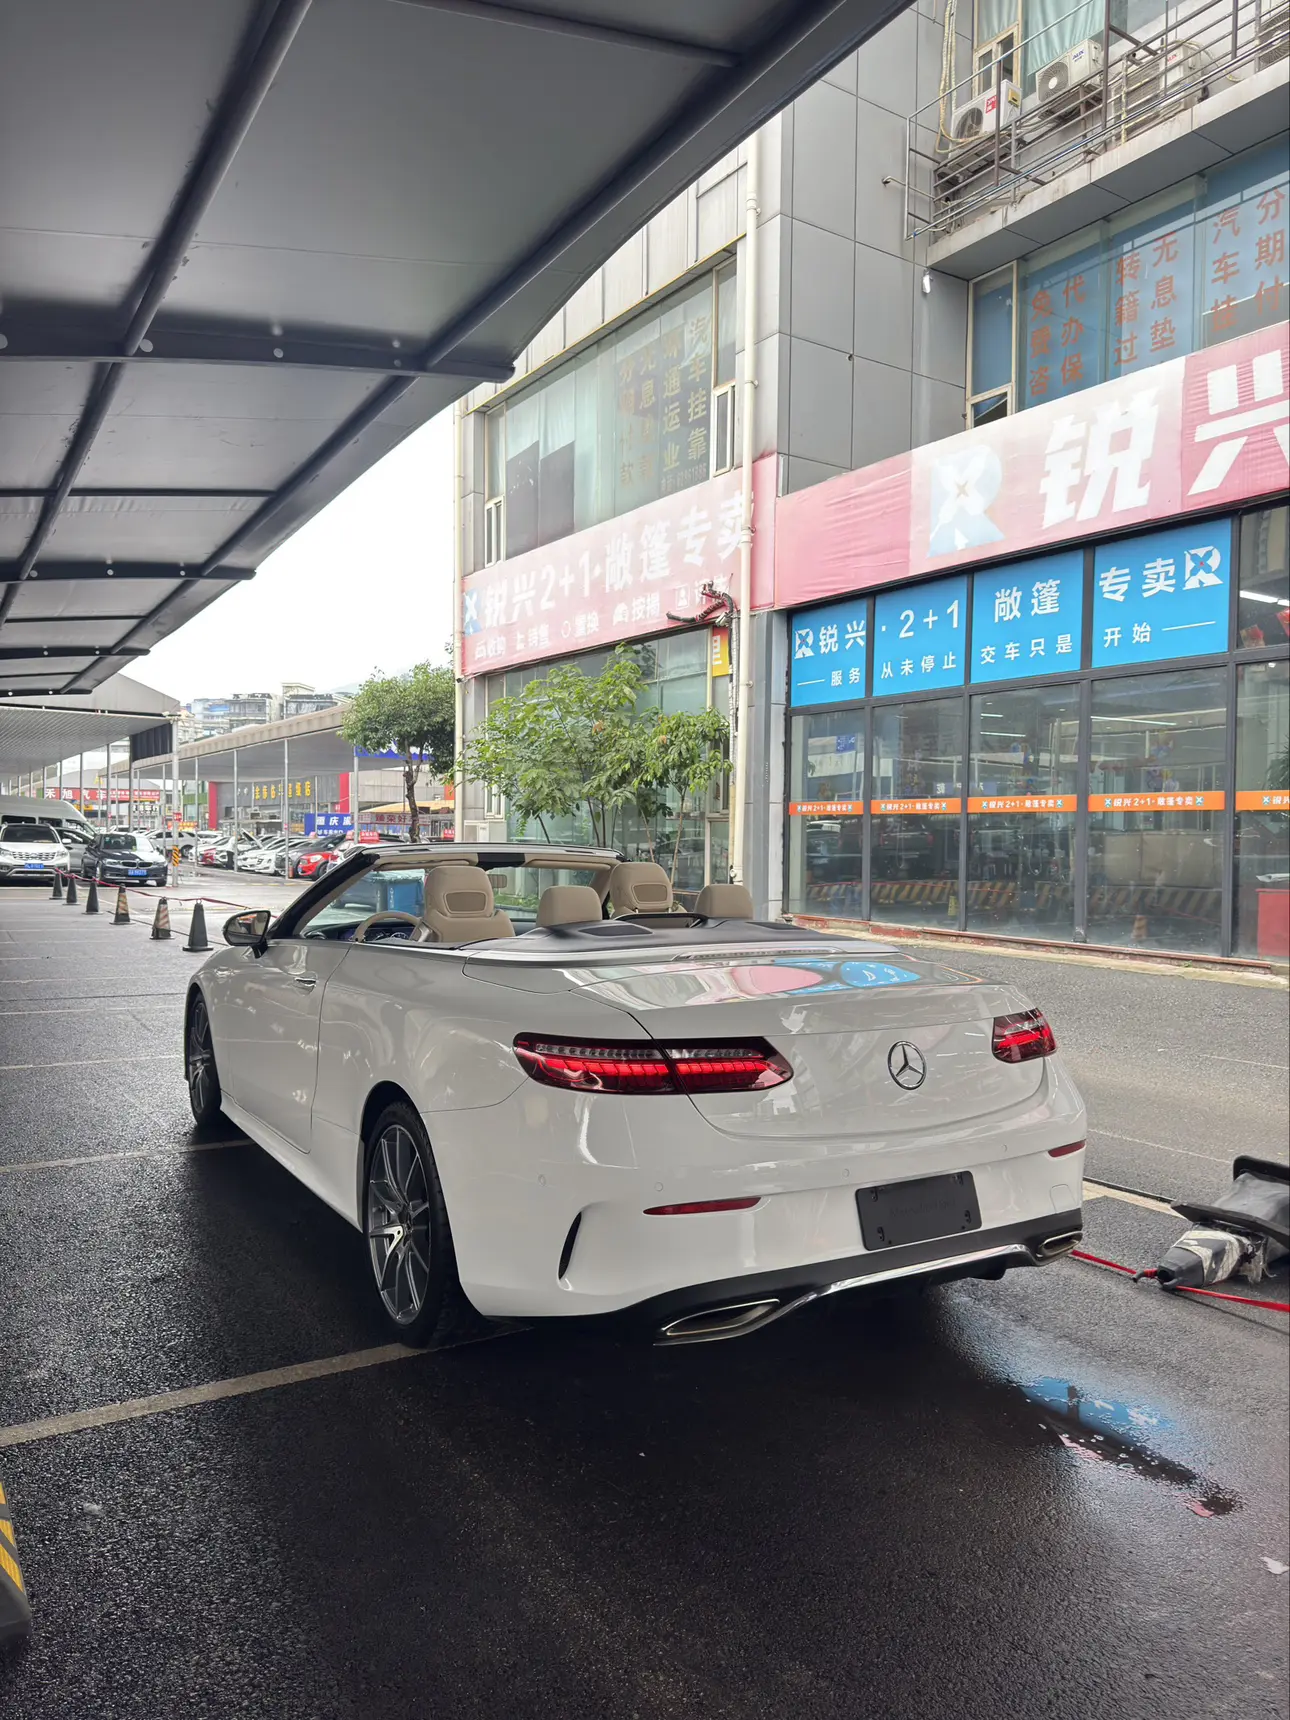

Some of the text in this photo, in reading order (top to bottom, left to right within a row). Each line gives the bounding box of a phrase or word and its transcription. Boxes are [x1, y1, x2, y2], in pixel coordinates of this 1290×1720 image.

[994, 577, 1062, 623] 敞篷
[1098, 556, 1176, 604] 专卖
[830, 621, 1152, 688] 服务 从未停止 交车只是 开始
